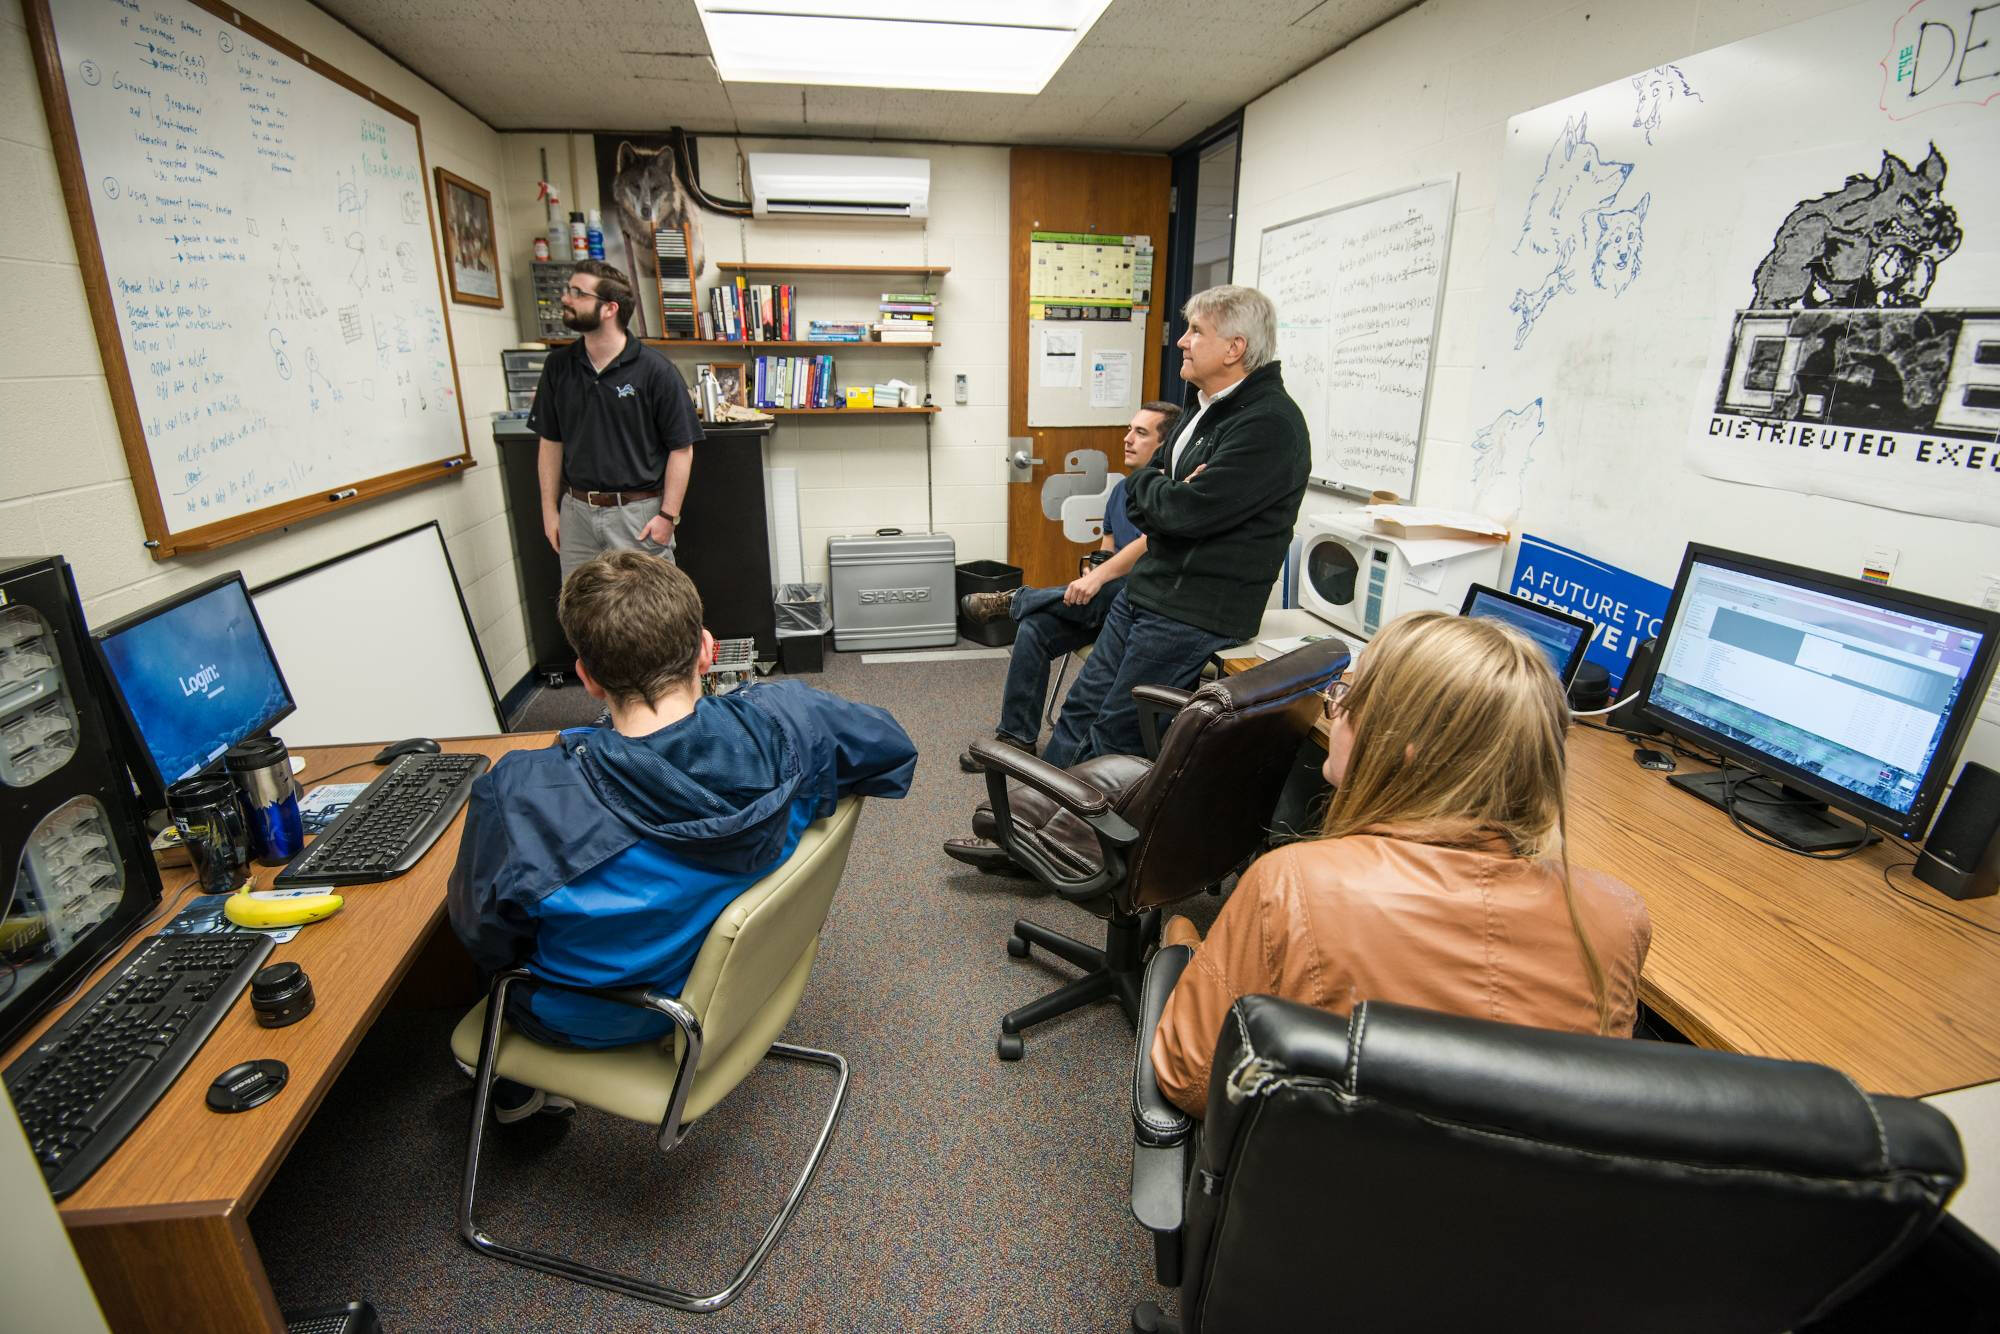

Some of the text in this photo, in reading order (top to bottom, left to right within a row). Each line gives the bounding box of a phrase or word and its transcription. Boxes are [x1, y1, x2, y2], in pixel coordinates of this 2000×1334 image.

[1897, 44, 1914, 82] THE
[1709, 417, 1896, 458] DISTRIBUTED
[859, 588, 930, 604] SHARP
[1520, 565, 1535, 585] A
[1540, 571, 1629, 624] FUTURE
[178, 663, 220, 697] Login:
[230, 1071, 264, 1093] Nikon
